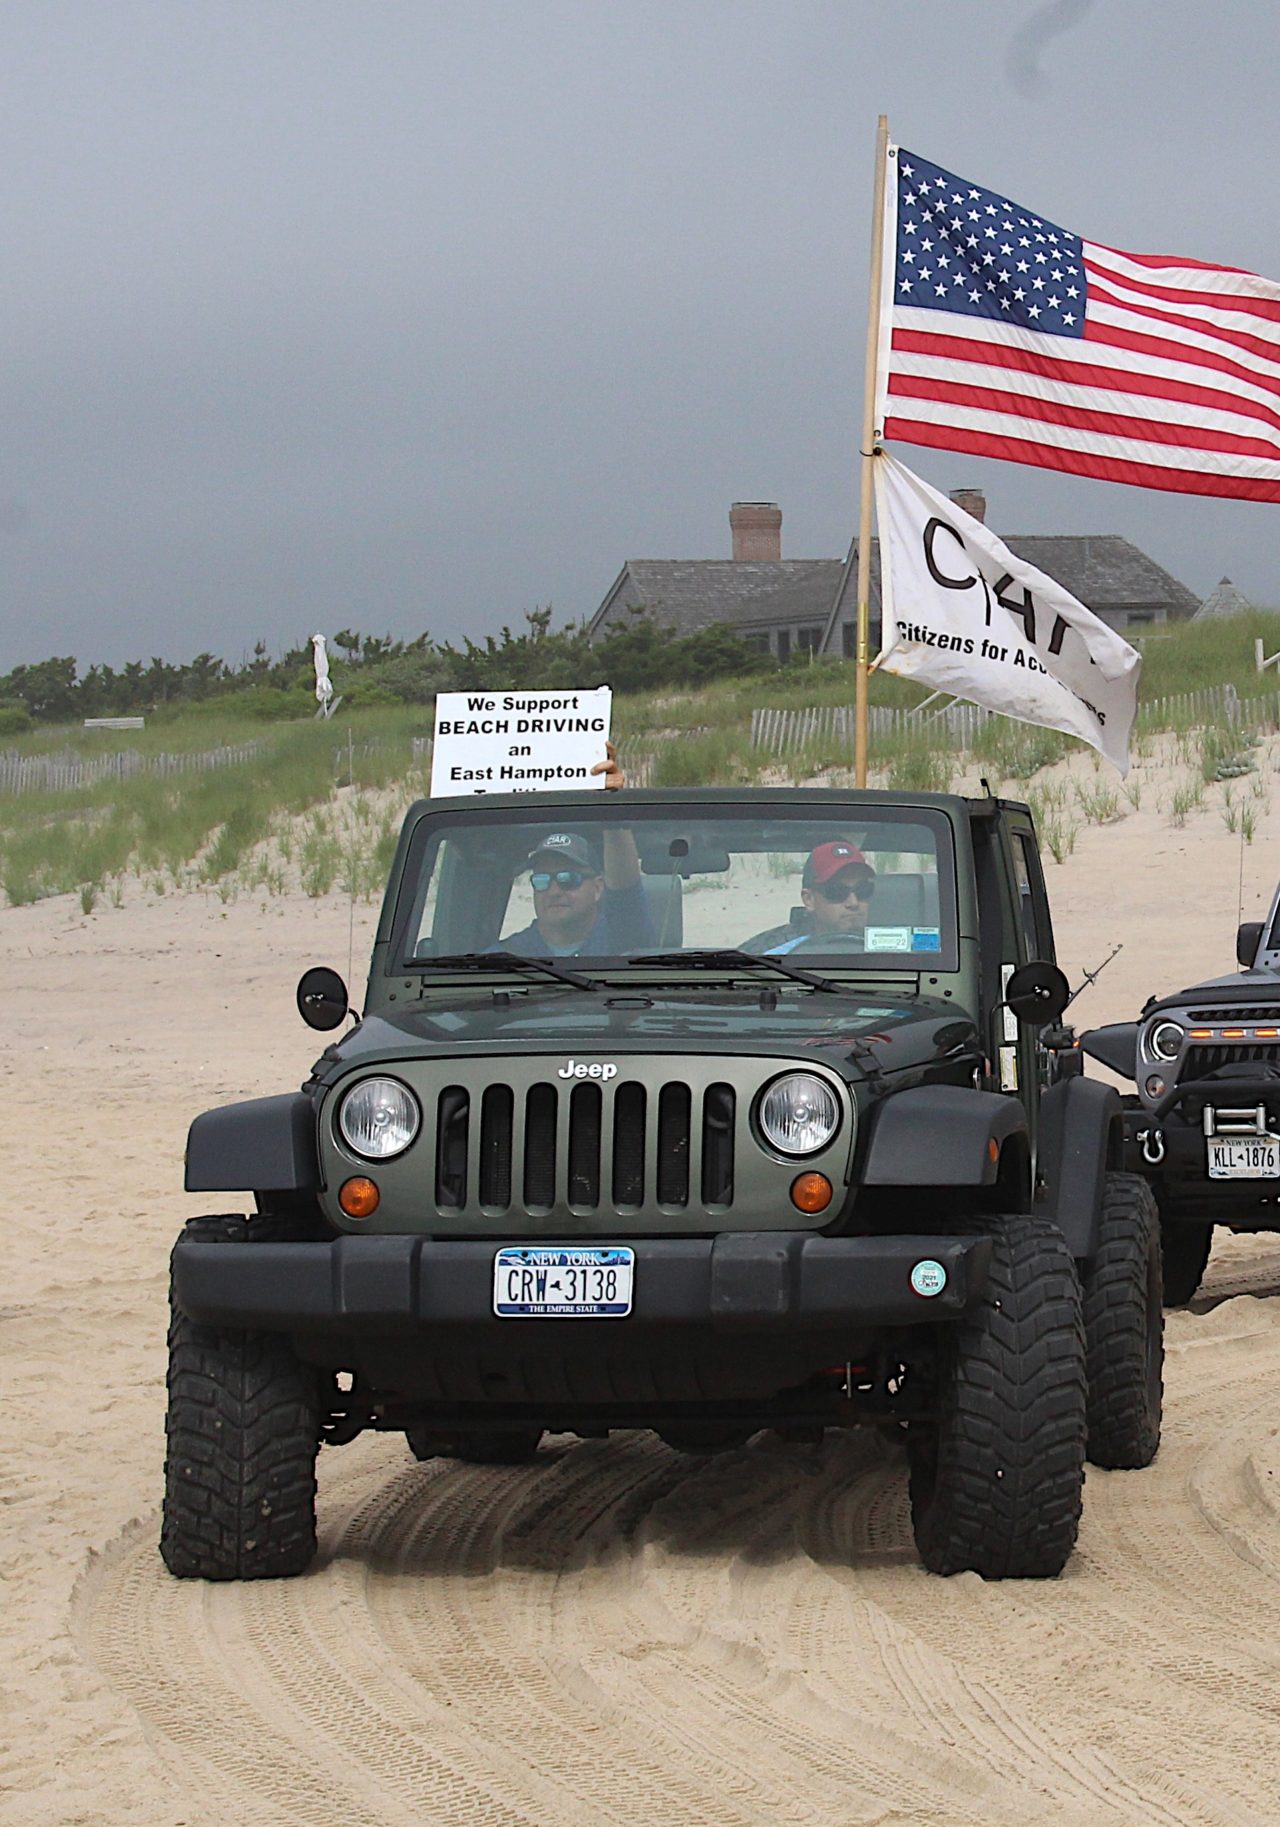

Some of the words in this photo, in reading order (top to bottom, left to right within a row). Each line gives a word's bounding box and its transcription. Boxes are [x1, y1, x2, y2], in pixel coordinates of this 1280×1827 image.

[980, 638, 1009, 662] for
[467, 697, 496, 712] We
[502, 695, 579, 713] Support
[438, 720, 509, 735] BEACH
[516, 718, 605, 734] DRIVING
[508, 745, 531, 756] an
[450, 766, 493, 781] East
[500, 764, 587, 782] Hampton
[558, 1060, 617, 1081] Jeep
[1225, 1139, 1242, 1147] NEW
[1244, 1139, 1262, 1147] YORK
[1245, 1147, 1274, 1167] 1876
[530, 1252, 564, 1266] NEW
[565, 1252, 601, 1266] YORK
[529, 1305, 545, 1313] THE
[546, 1305, 574, 1313] EMPIRE
[575, 1305, 598, 1313] STATE
